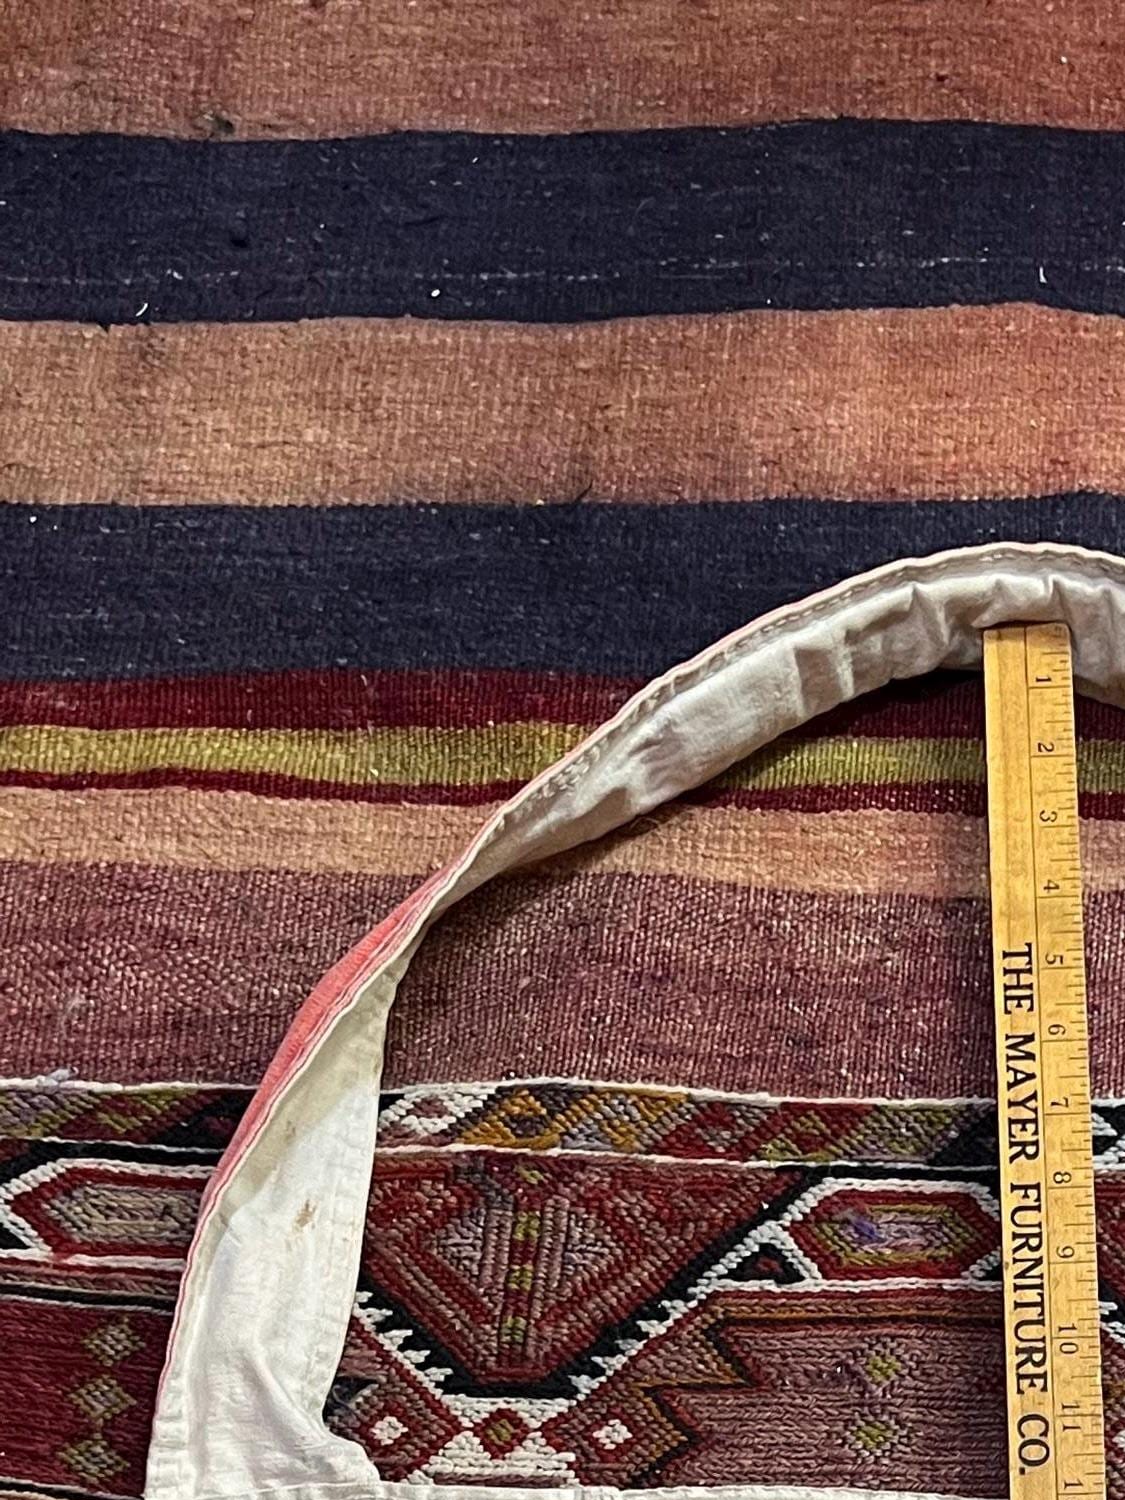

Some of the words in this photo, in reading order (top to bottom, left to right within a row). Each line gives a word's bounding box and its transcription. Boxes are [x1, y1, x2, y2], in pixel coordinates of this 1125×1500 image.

[1038, 742, 1055, 754] 2
[1039, 810, 1058, 823] 3
[1043, 880, 1060, 893] 4
[1045, 953, 1064, 966] 5
[1002, 942, 1035, 1016] THE
[1048, 1023, 1066, 1036] 6
[1005, 1032, 1040, 1164] MAYER
[1050, 1097, 1069, 1109] 7
[1053, 1171, 1072, 1184] 8
[1056, 1246, 1075, 1259] 9
[1010, 1181, 1049, 1396] FURNITURE
[1058, 1323, 1079, 1355] 10
[1061, 1403, 1081, 1433] 11
[1016, 1413, 1050, 1476] CO.
